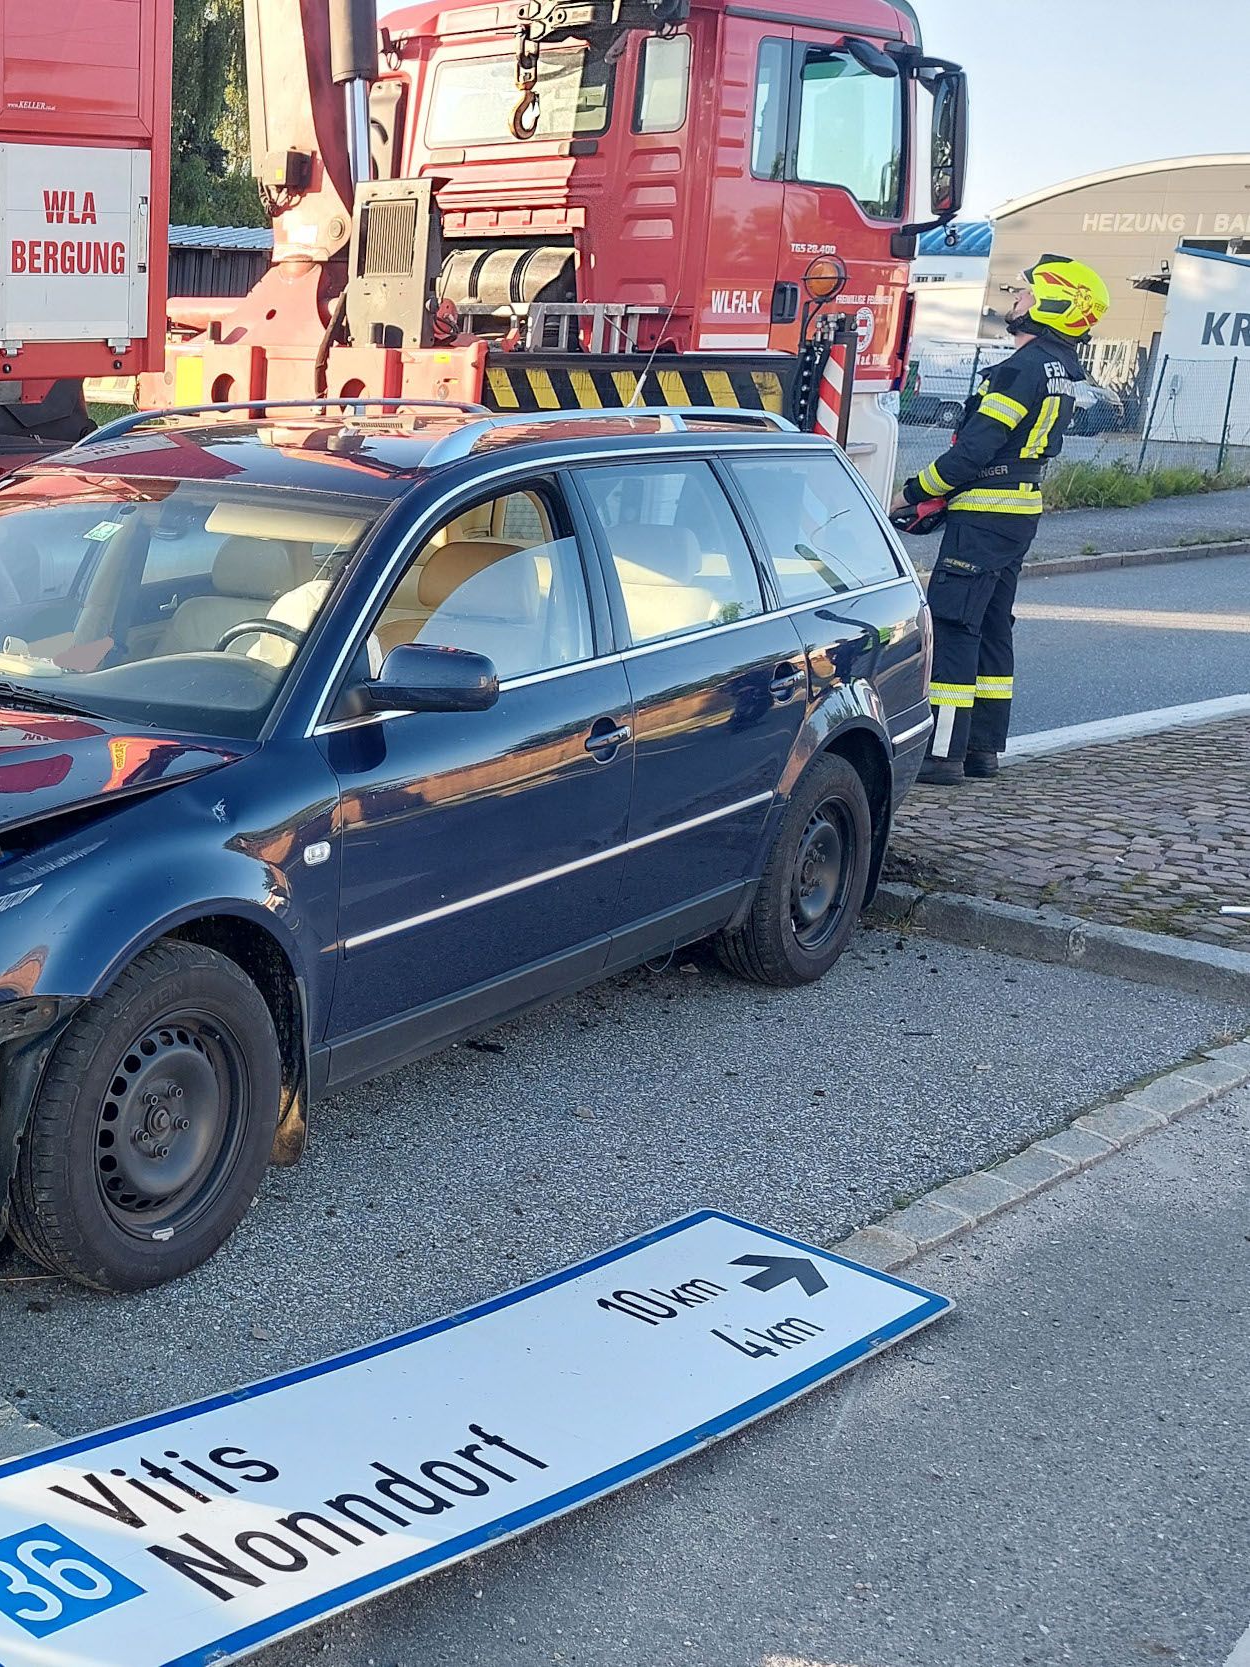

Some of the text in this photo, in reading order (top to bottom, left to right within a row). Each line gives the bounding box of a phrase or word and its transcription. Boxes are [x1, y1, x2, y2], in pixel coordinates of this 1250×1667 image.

[43, 190, 97, 225] WLA
[1082, 213, 1186, 232] HEIZUNG
[11, 240, 126, 275] BERGUNG
[711, 290, 763, 314] WLFA-K
[596, 1278, 729, 1326] 10 km
[709, 1317, 826, 1359] 4 km
[47, 1442, 280, 1529] Vitis
[145, 1423, 550, 1602] Nonndorf
